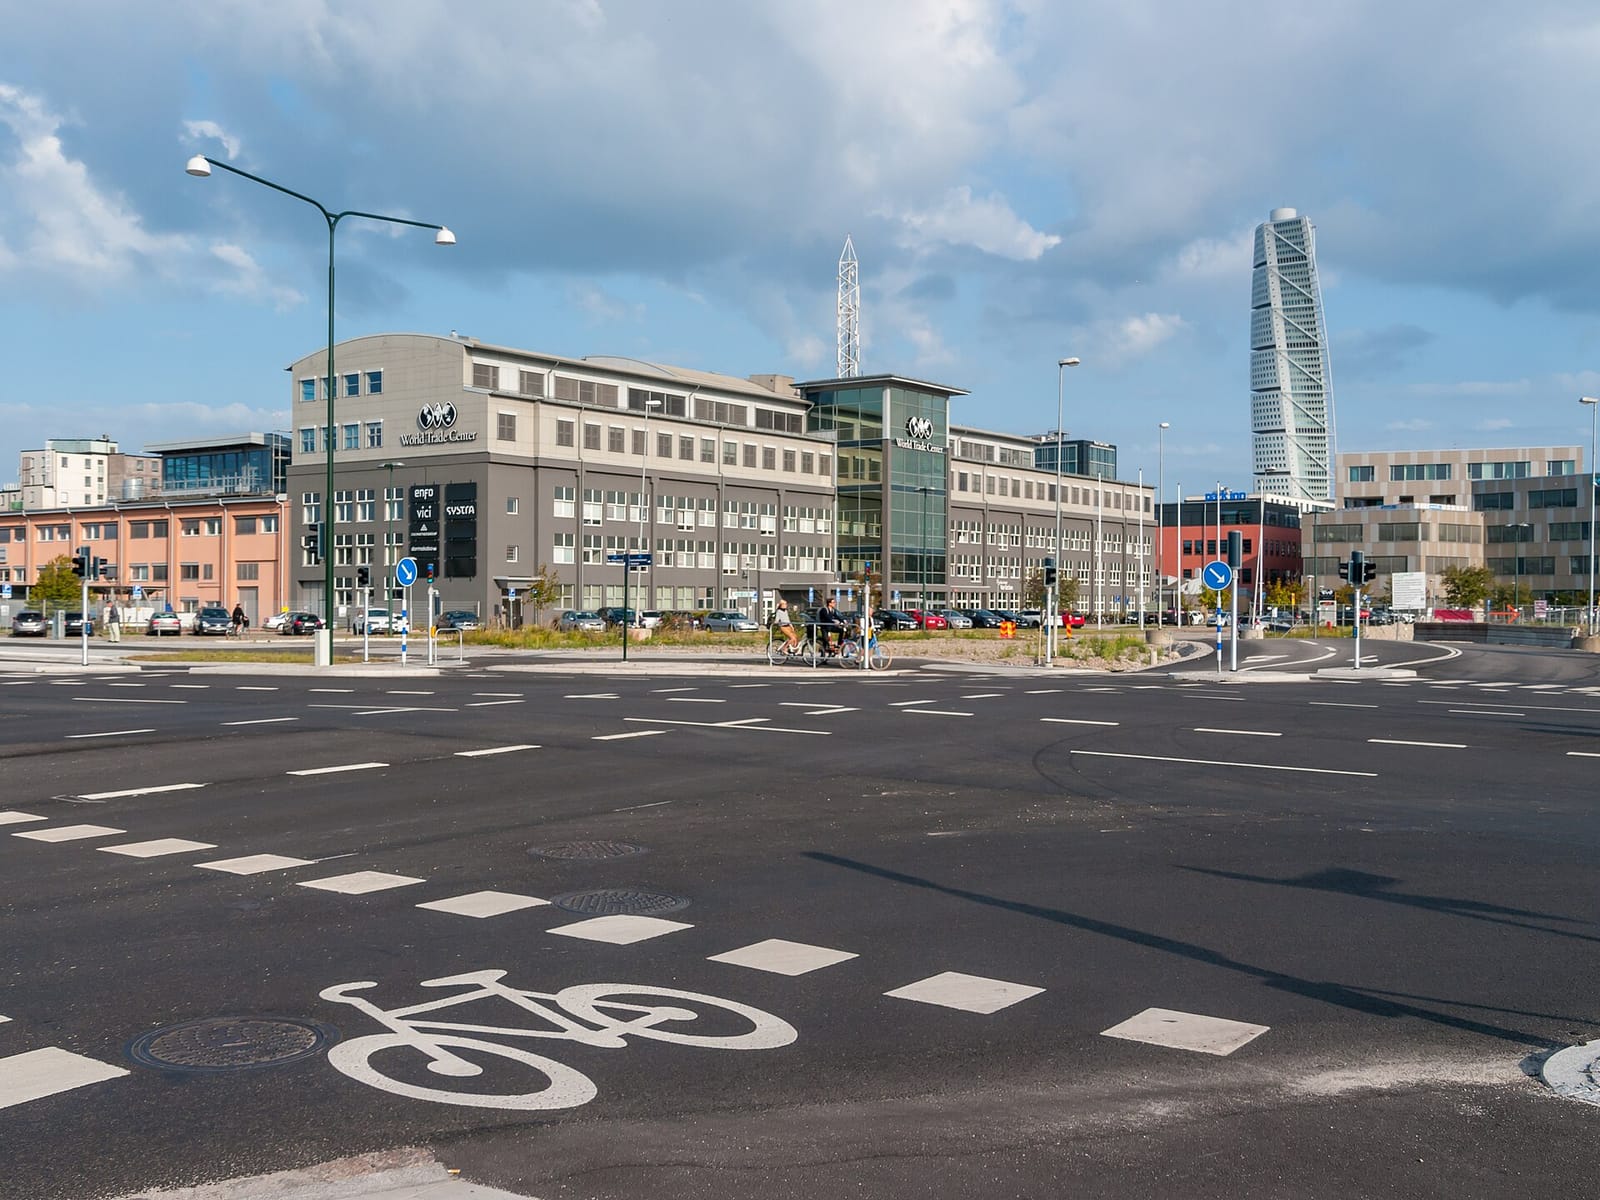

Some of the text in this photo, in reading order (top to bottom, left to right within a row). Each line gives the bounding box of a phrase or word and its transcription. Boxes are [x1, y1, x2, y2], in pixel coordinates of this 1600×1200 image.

[400, 429, 477, 446] World Trade Center
[895, 438, 944, 453] World Trade Center
[414, 488, 434, 500] enfo
[416, 505, 432, 518] vici
